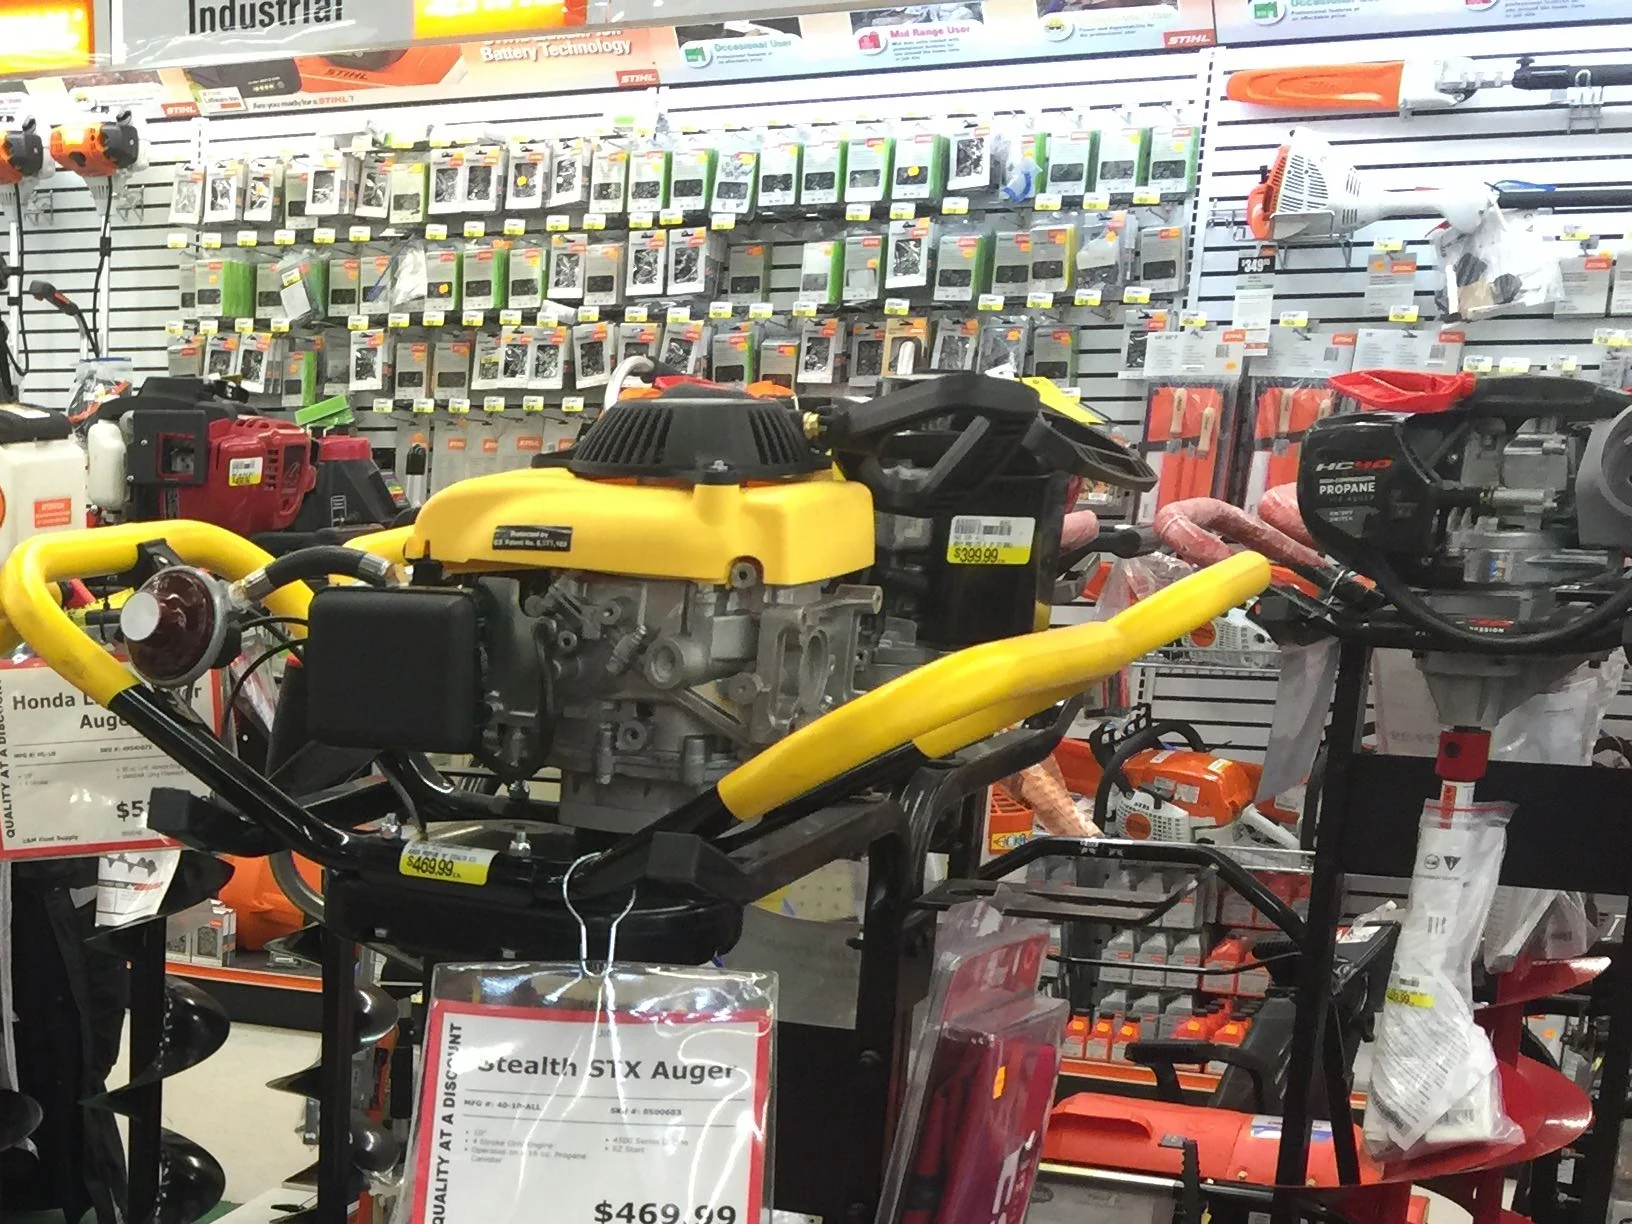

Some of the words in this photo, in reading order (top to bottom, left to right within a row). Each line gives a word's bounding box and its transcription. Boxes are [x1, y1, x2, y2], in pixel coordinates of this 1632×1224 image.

[188, 0, 345, 35] Industrial
[890, 29, 909, 38] Mid
[913, 27, 944, 38] Range
[947, 25, 970, 34] User
[1168, 33, 1211, 45] STIHL
[480, 39, 539, 62] Battery
[541, 37, 632, 58] Technology
[324, 68, 368, 80] STIHL
[619, 73, 656, 84] STIHL
[166, 106, 196, 115] STIHL
[1316, 457, 1393, 472] HC40
[1319, 482, 1376, 495] PROPANE
[954, 547, 999, 563] $399.99
[13, 692, 76, 711] Honda
[80, 714, 132, 731] Auge
[0, 761, 9, 778] AT
[0, 780, 15, 839] QUALITY
[407, 856, 454, 877] $469.99
[588, 1059, 642, 1078] STX
[651, 1063, 737, 1085] Auger
[442, 1113, 454, 1125] A
[439, 1130, 452, 1151] AT
